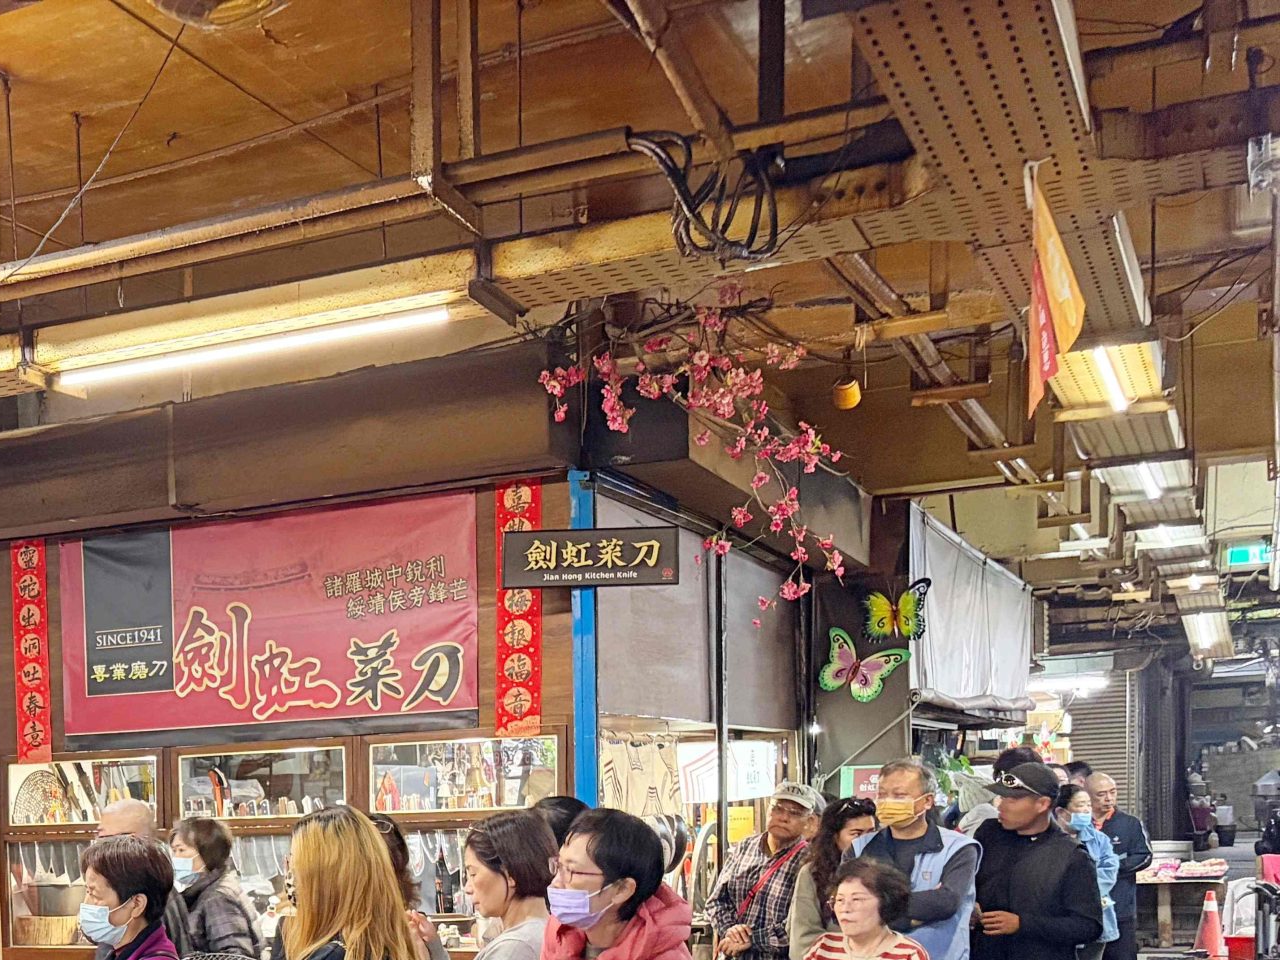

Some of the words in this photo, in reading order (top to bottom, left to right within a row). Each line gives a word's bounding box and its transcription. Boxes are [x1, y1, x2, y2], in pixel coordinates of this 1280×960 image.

[523, 538, 660, 571] 劍虹菜刀
[562, 573, 582, 581] Hong
[616, 570, 638, 578] Knife
[96, 628, 162, 646] SINCE1941
